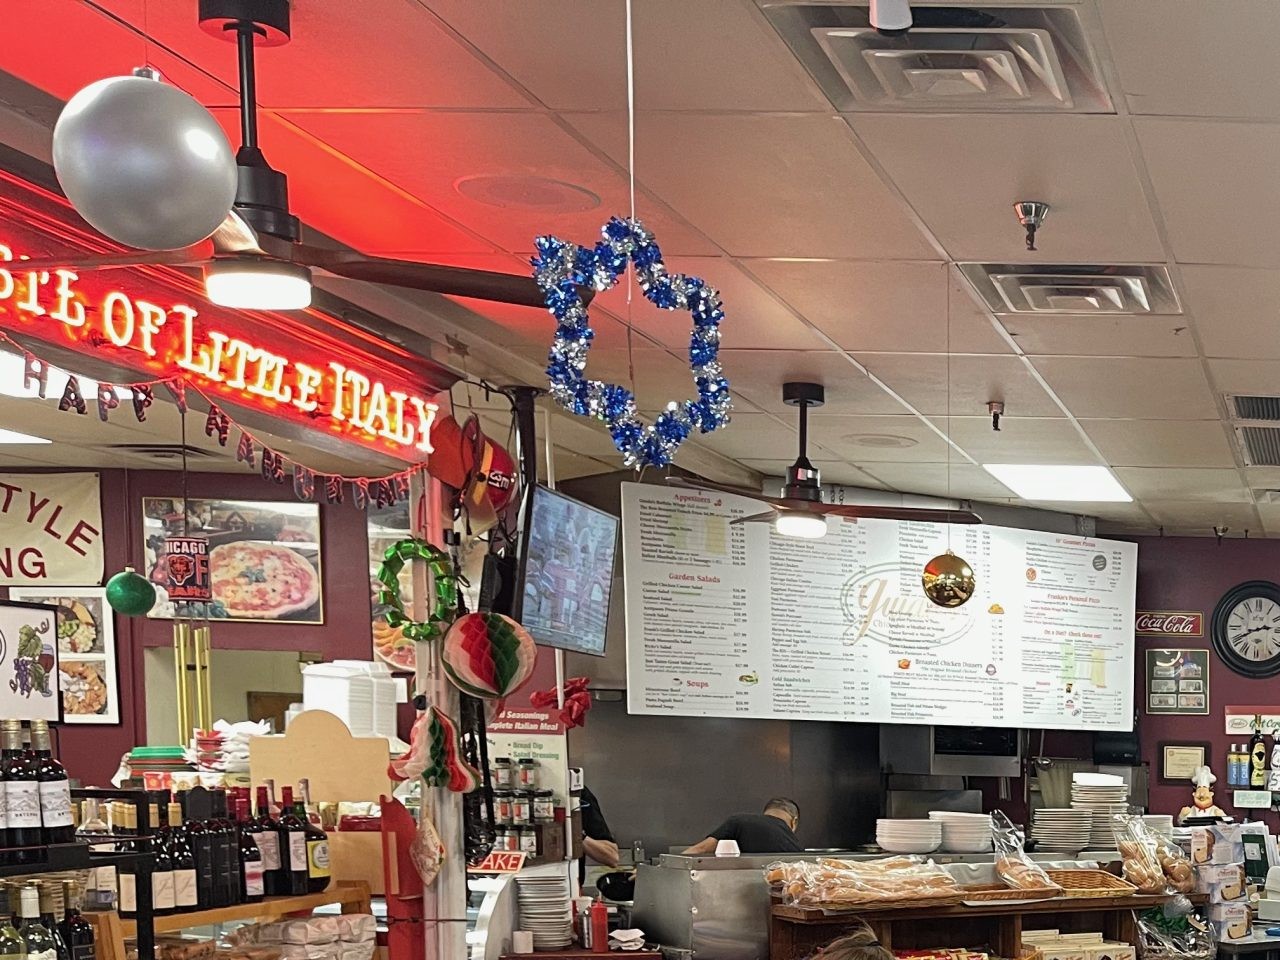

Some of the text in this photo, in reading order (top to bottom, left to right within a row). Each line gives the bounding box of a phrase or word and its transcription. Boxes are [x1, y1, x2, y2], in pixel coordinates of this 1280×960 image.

[105, 292, 166, 356] OF
[167, 305, 322, 411] LITTLE
[329, 362, 440, 454] ITALY
[669, 572, 721, 583] Garden Salads
[687, 680, 709, 689] Soups
[506, 711, 549, 721] Seasonings
[514, 721, 538, 730] Italian
[539, 721, 559, 731] Meal
[532, 742, 544, 750] Dip
[532, 751, 560, 760] Dressing
